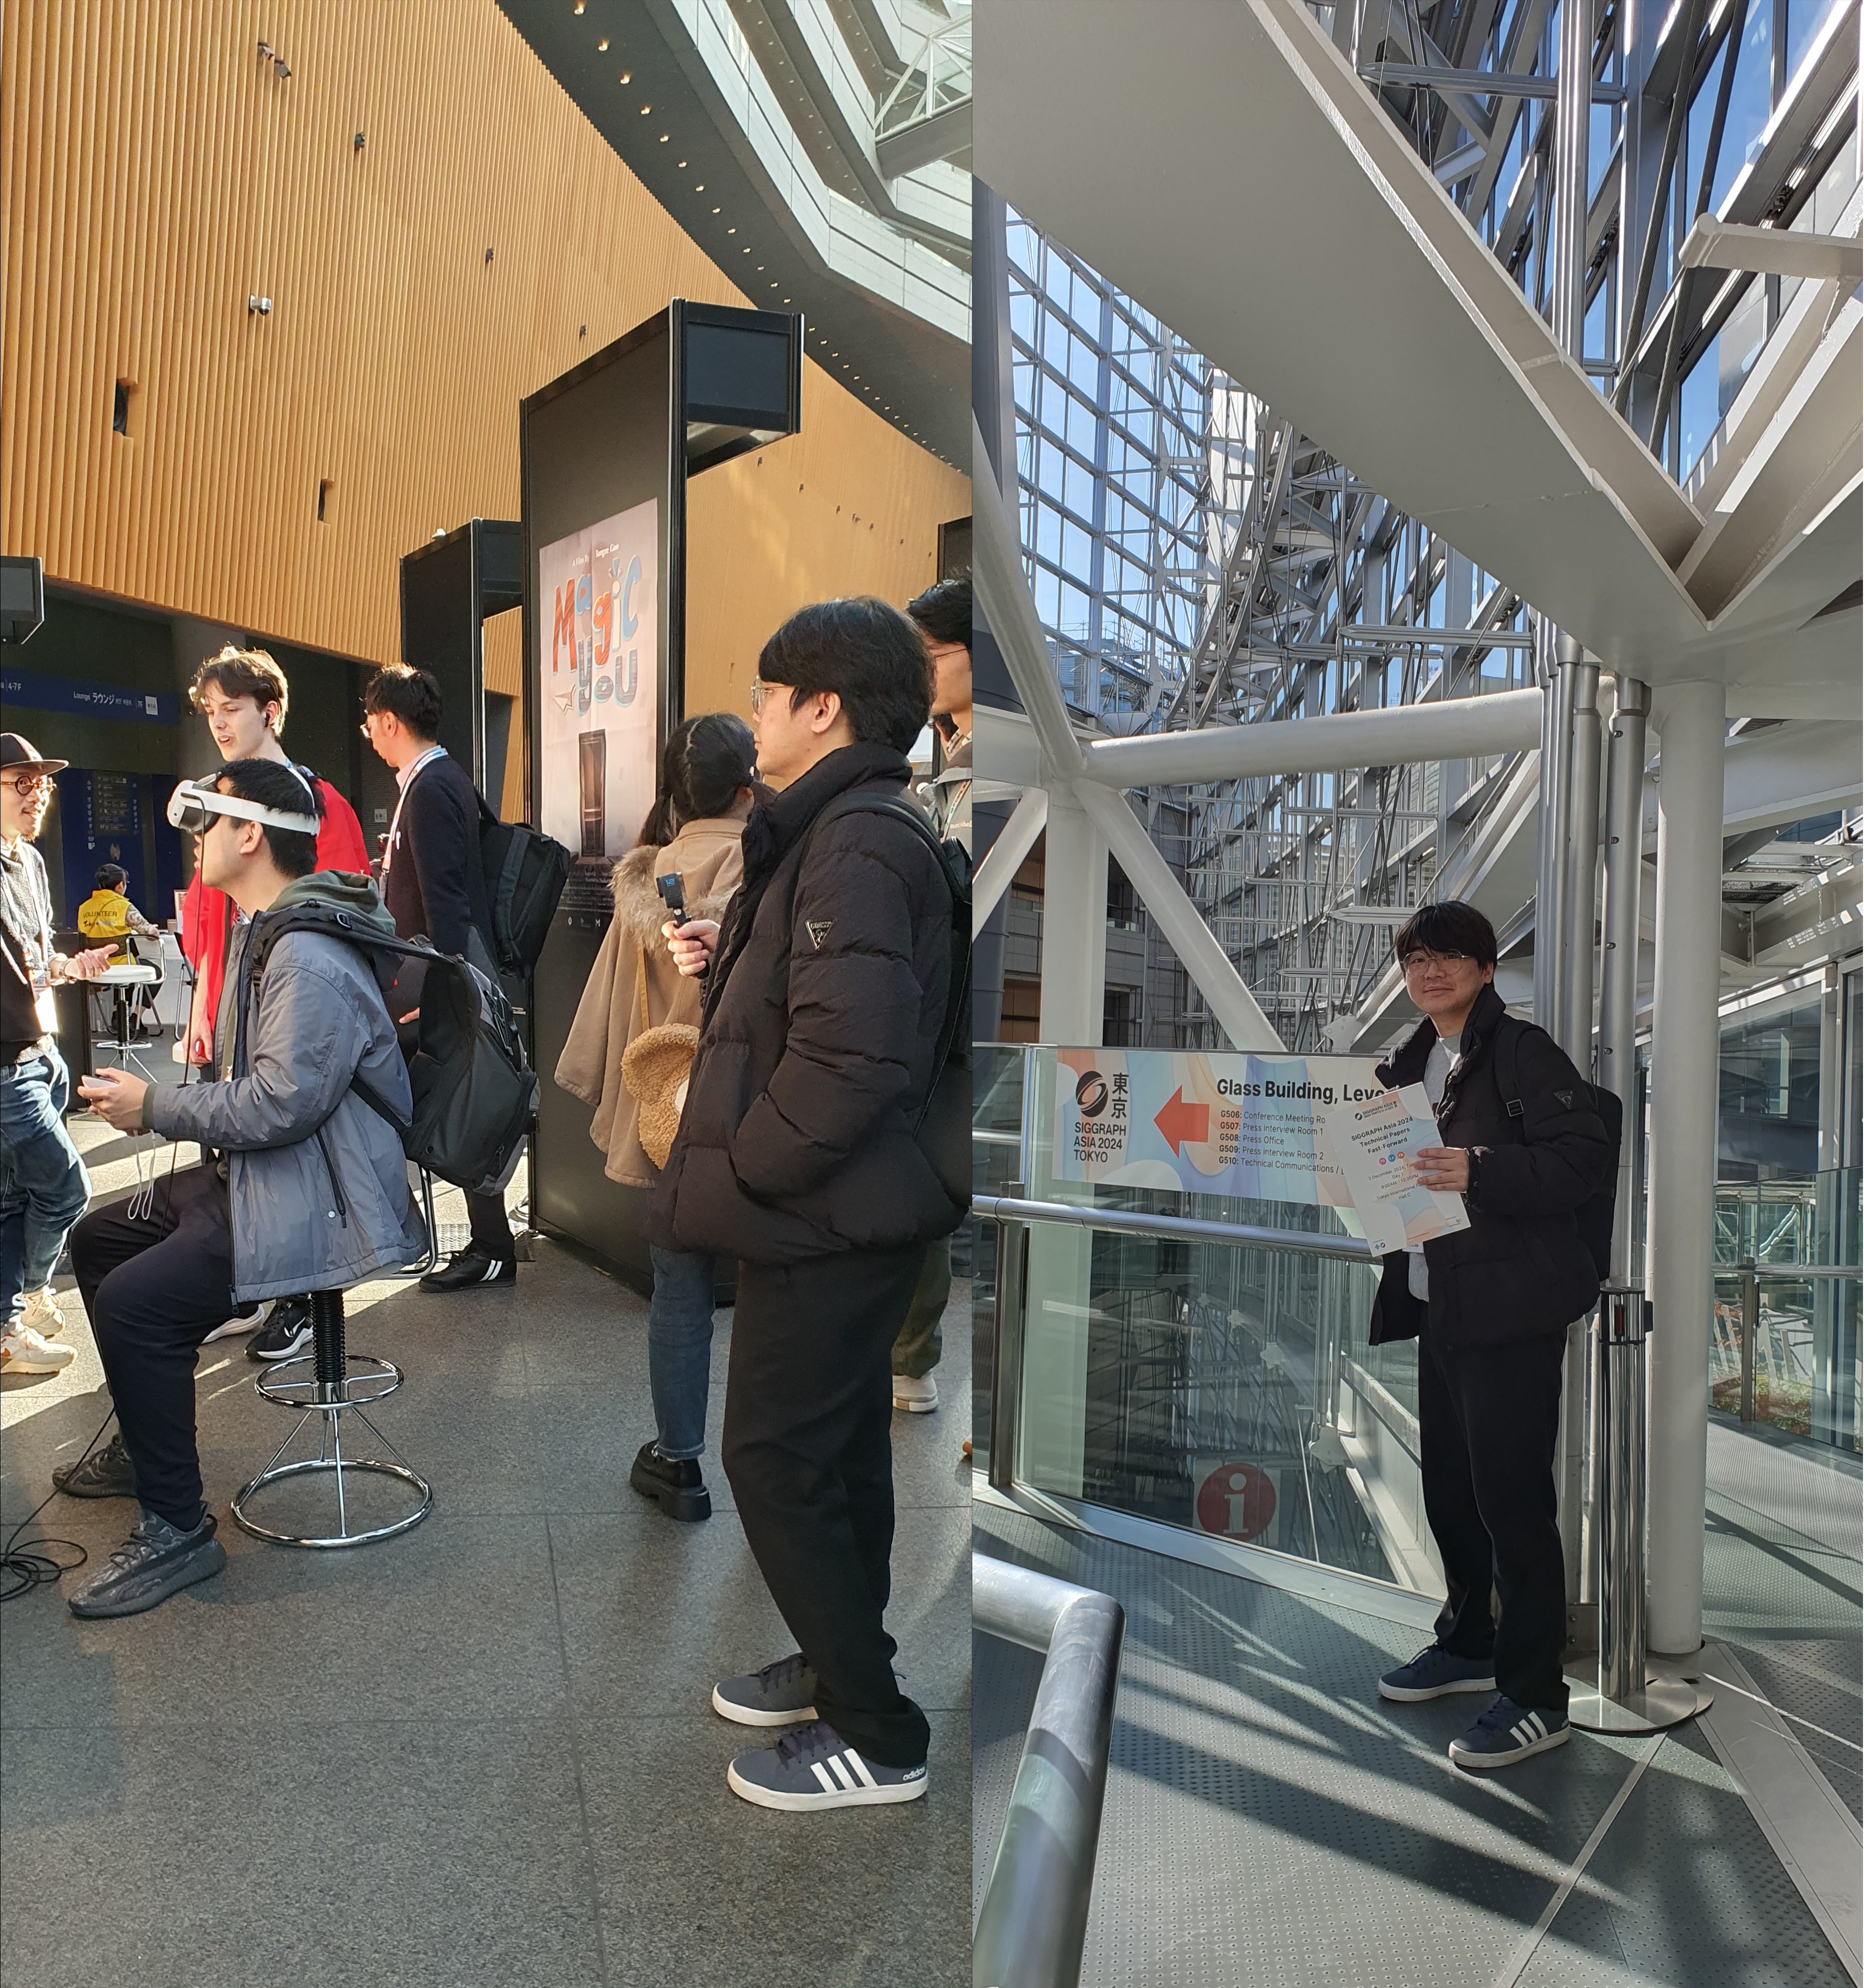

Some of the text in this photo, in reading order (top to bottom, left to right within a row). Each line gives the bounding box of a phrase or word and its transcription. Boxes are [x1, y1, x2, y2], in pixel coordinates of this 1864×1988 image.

[73, 692, 90, 702] Lounge
[92, 692, 115, 705] ラウンジ
[137, 700, 143, 708] 7F
[1111, 1072, 1129, 1119] 東京
[1217, 1078, 1261, 1096] Glass
[1265, 1080, 1338, 1105] Building,
[1221, 1110, 1242, 1119] G506:
[1244, 1111, 1284, 1122] Conference
[1286, 1114, 1314, 1125] Meeting
[1362, 1105, 1383, 1115] SIGGRAPH
[1075, 1122, 1126, 1136] SIGGRAPH
[1220, 1122, 1241, 1130] G507:
[1243, 1124, 1262, 1132] Press
[1264, 1125, 1295, 1134] Interview
[1297, 1127, 1318, 1135] Room
[1351, 1126, 1382, 1141] SIGGRAPH
[1397, 1116, 1413, 1126] 2024
[1074, 1136, 1123, 1150] ASIA 2024
[1220, 1133, 1285, 1145] G508: Press Office
[1360, 1127, 1410, 1147] Technical Papers
[1219, 1145, 1240, 1154] G509:
[1242, 1146, 1261, 1155] Press
[1263, 1148, 1295, 1158] Interview
[1297, 1151, 1318, 1160] Room
[1368, 1137, 1407, 1154] Fast-Forward
[1074, 1149, 1108, 1162] TOKYO
[1219, 1156, 1239, 1165] G510:
[1241, 1158, 1273, 1168] Technical
[1275, 1161, 1334, 1173] Communications
[1372, 1170, 1392, 1179] December
[1381, 1181, 1397, 1189] 9:00AM
[1390, 1184, 1415, 1196] International
[903, 1766, 925, 1781] adidas
